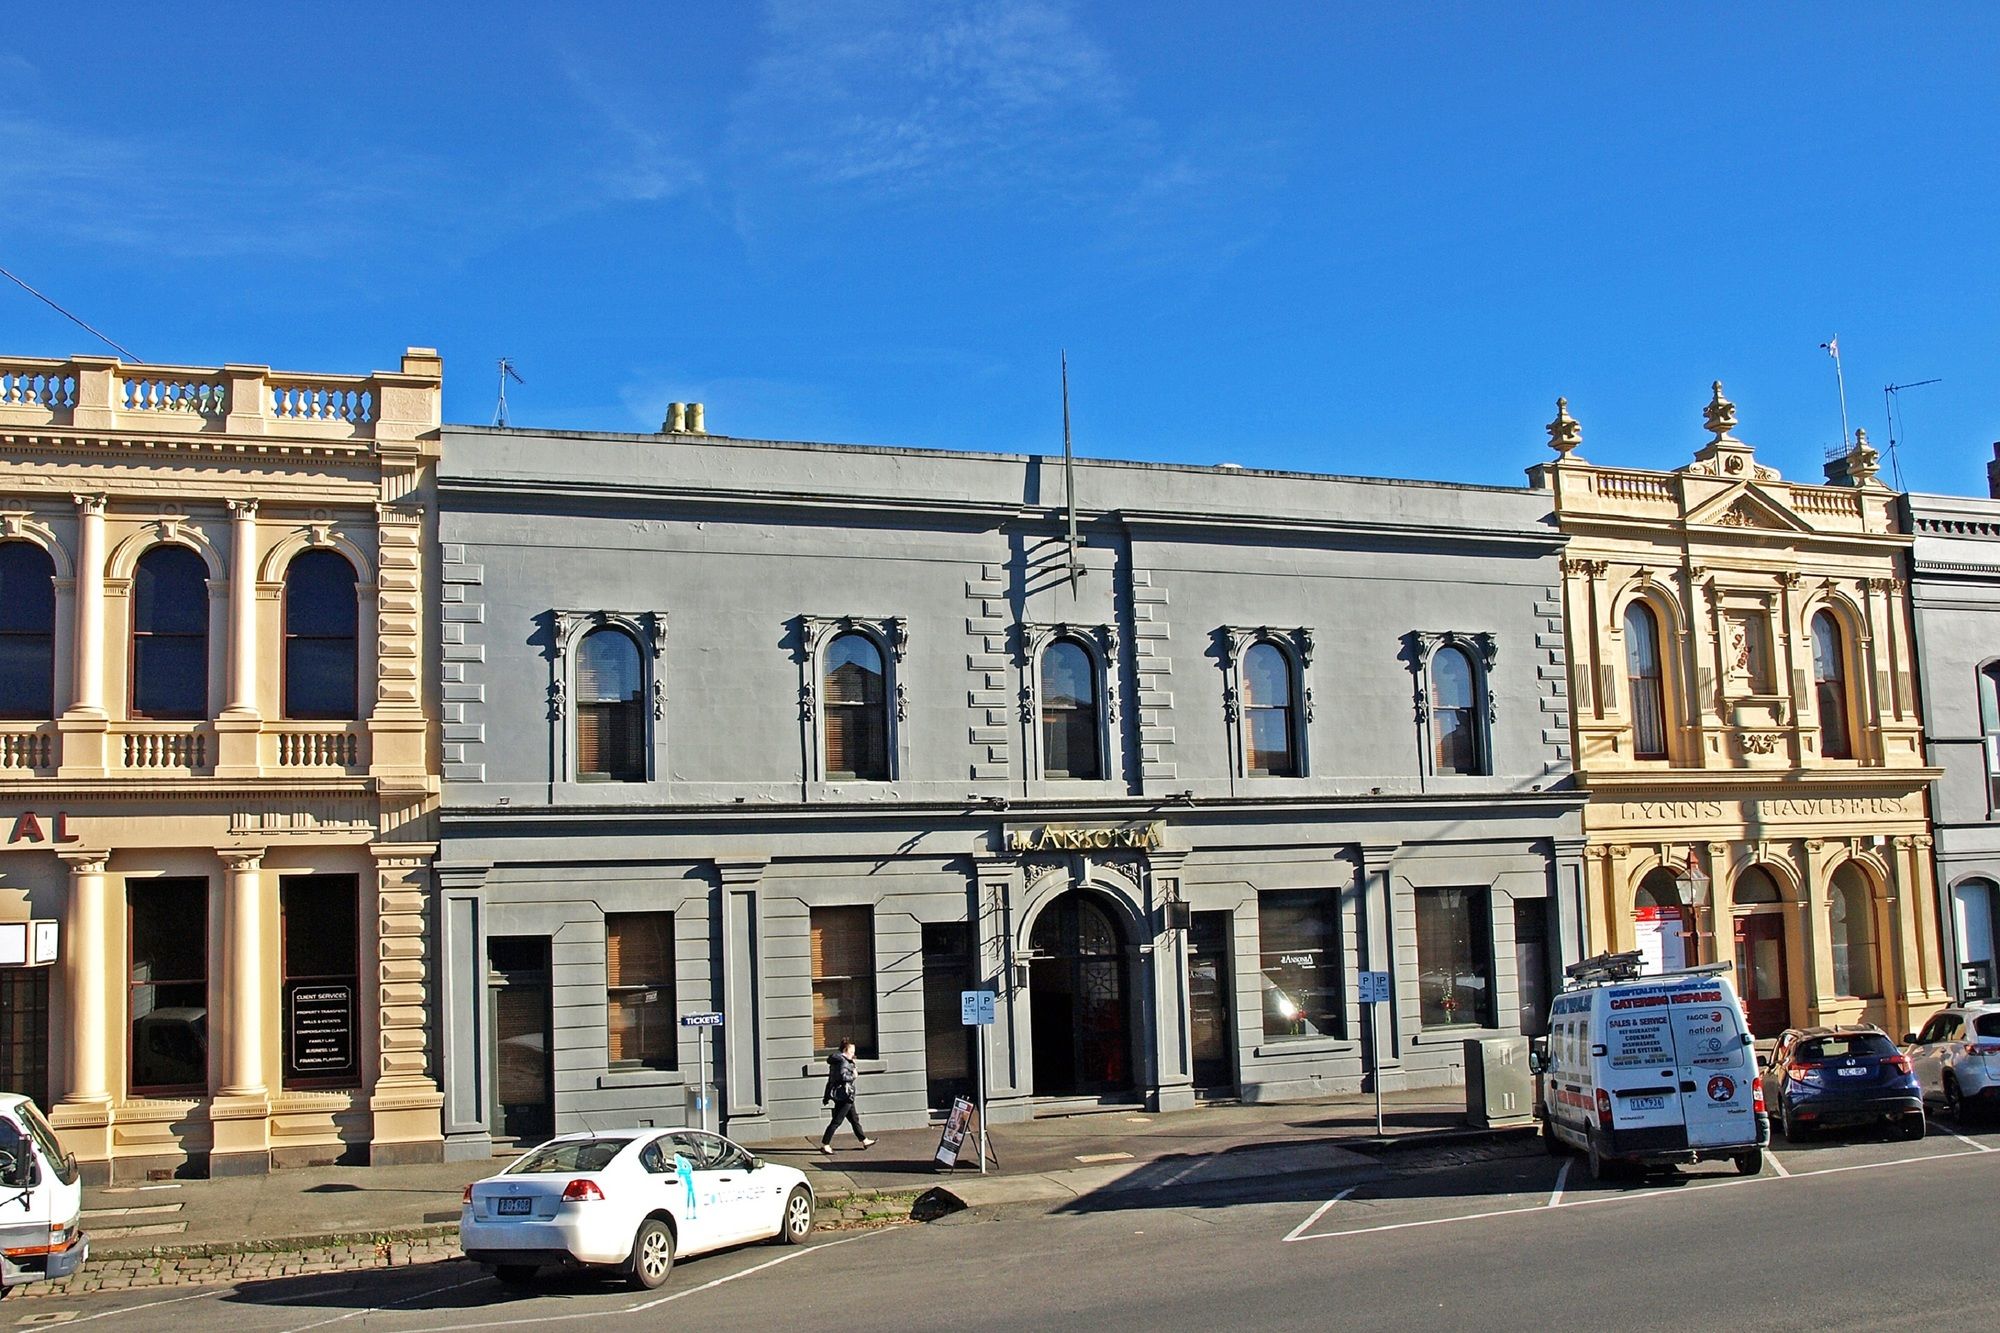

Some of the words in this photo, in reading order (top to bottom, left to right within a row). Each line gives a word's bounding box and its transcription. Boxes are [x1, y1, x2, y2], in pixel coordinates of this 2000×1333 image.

[1610, 996, 1670, 1010] CATERING
[1670, 991, 1722, 1005] REPAIRS
[686, 1015, 720, 1025] TICKETS
[1609, 1019, 1631, 1028] SALES
[1632, 1018, 1637, 1026] &
[1639, 1016, 1667, 1025] SERVICE
[1689, 1024, 1723, 1035] national
[1637, 1046, 1663, 1054] SYSTEMS
